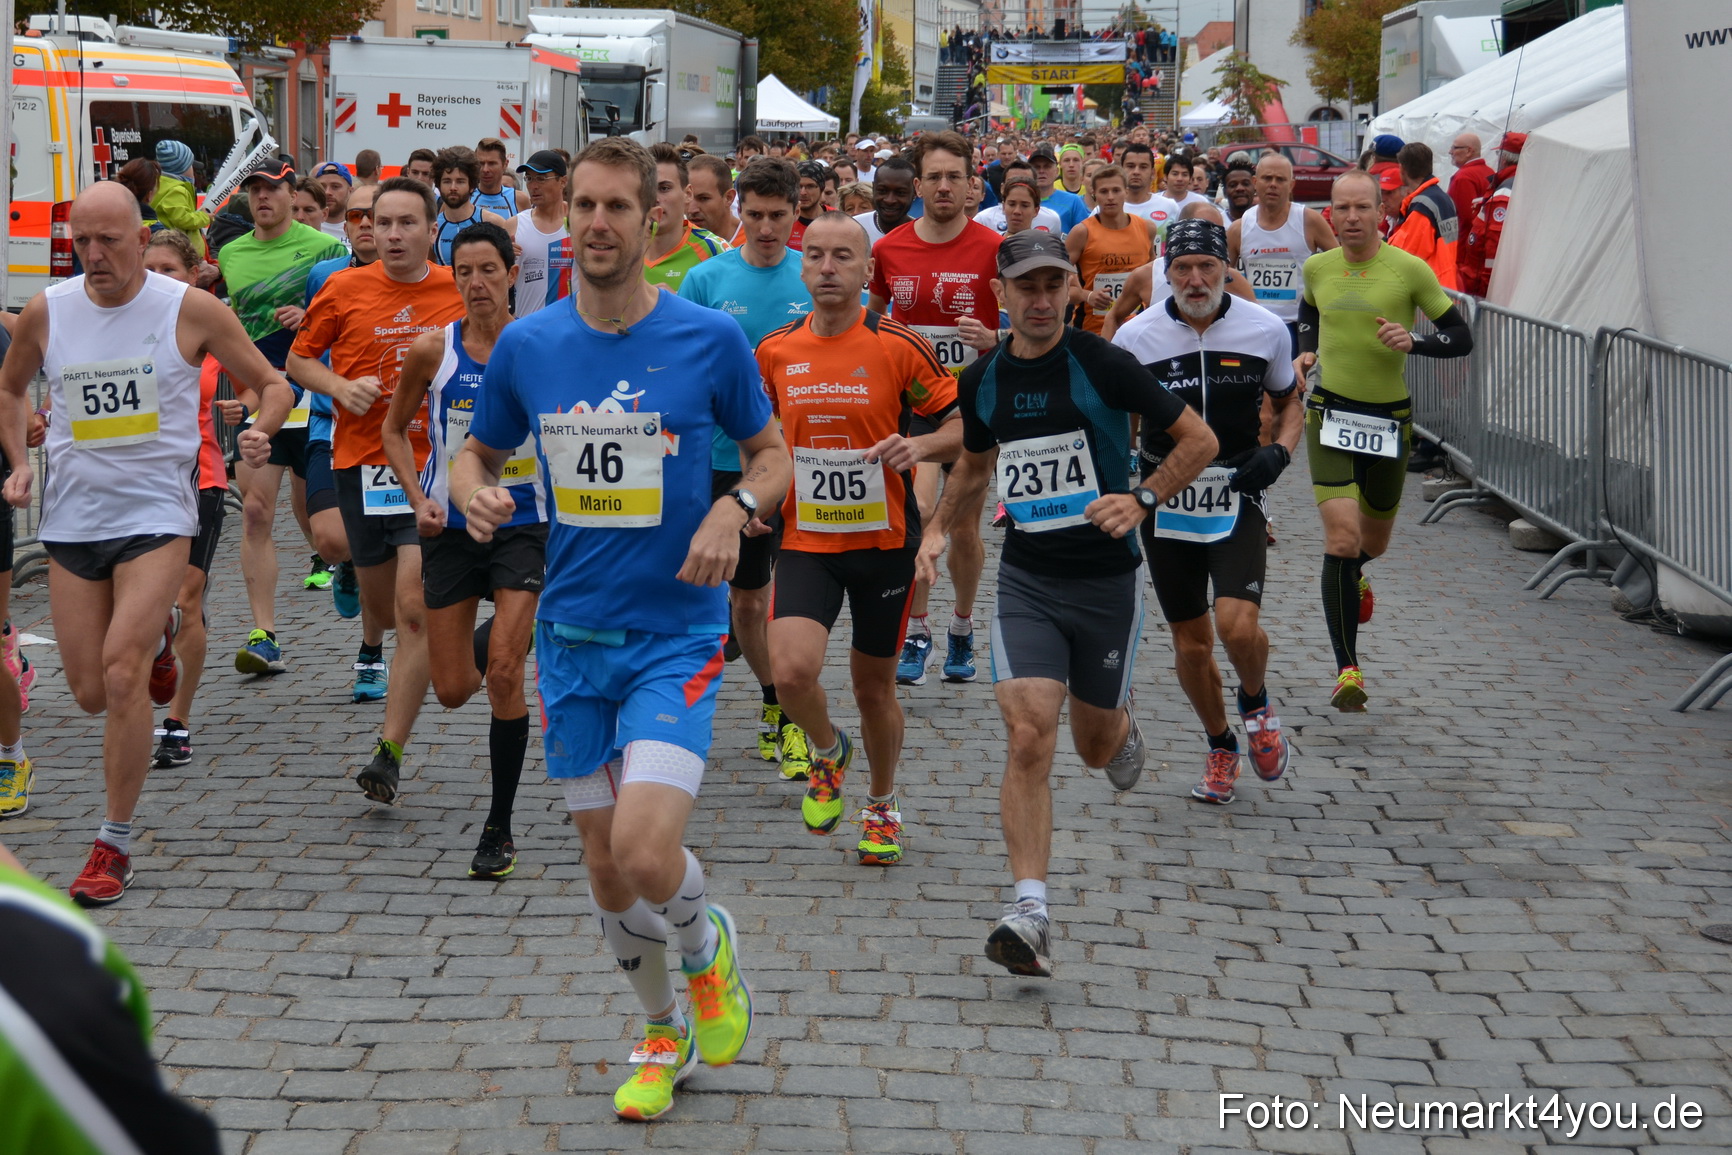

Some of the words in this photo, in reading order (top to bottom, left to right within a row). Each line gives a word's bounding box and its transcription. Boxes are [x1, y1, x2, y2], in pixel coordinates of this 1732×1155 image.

[1685, 27, 1732, 49] ww
[1031, 69, 1078, 80] START
[417, 93, 481, 105] Bayerisches
[417, 107, 447, 117] Rotes
[416, 120, 447, 130] Kreuz
[760, 119, 803, 129] Laufsport
[111, 127, 142, 146] Bayerisches
[113, 145, 129, 161] Rotes
[211, 142, 273, 206] bmw-laufsport.de
[1105, 255, 1133, 266] OEXL
[1253, 270, 1293, 287] 2657
[894, 292, 912, 300] NEU
[1262, 291, 1280, 299] Peter
[374, 325, 441, 336] SportScheck
[63, 371, 93, 382] PARTL
[94, 367, 139, 378] Neumarkt
[786, 362, 811, 376] DAK
[1167, 370, 1184, 378] Nalini
[459, 373, 483, 383] HEITE
[1161, 377, 1199, 390] EAM
[1207, 374, 1261, 384] NALINI
[787, 382, 869, 397] SportScheck
[82, 380, 141, 416] 534
[451, 398, 474, 409] LAC
[825, 396, 852, 404] Stadtlauf
[853, 397, 870, 405] 2009
[449, 417, 471, 427] PART
[1351, 420, 1386, 432] Neumarkt
[543, 425, 579, 436] PARTL
[581, 425, 639, 436] Neumarkt
[1337, 428, 1383, 453] 500
[1024, 444, 1070, 459] Neumarkt
[576, 441, 624, 484] 46
[796, 455, 822, 466] PARTL
[822, 457, 866, 467] Neumarkt
[1005, 455, 1086, 498] 2374
[1196, 475, 1225, 483] umarkt
[811, 470, 867, 502] 205
[580, 494, 622, 512] Mario
[816, 508, 865, 521] Berthold
[1031, 502, 1068, 519] Andre
